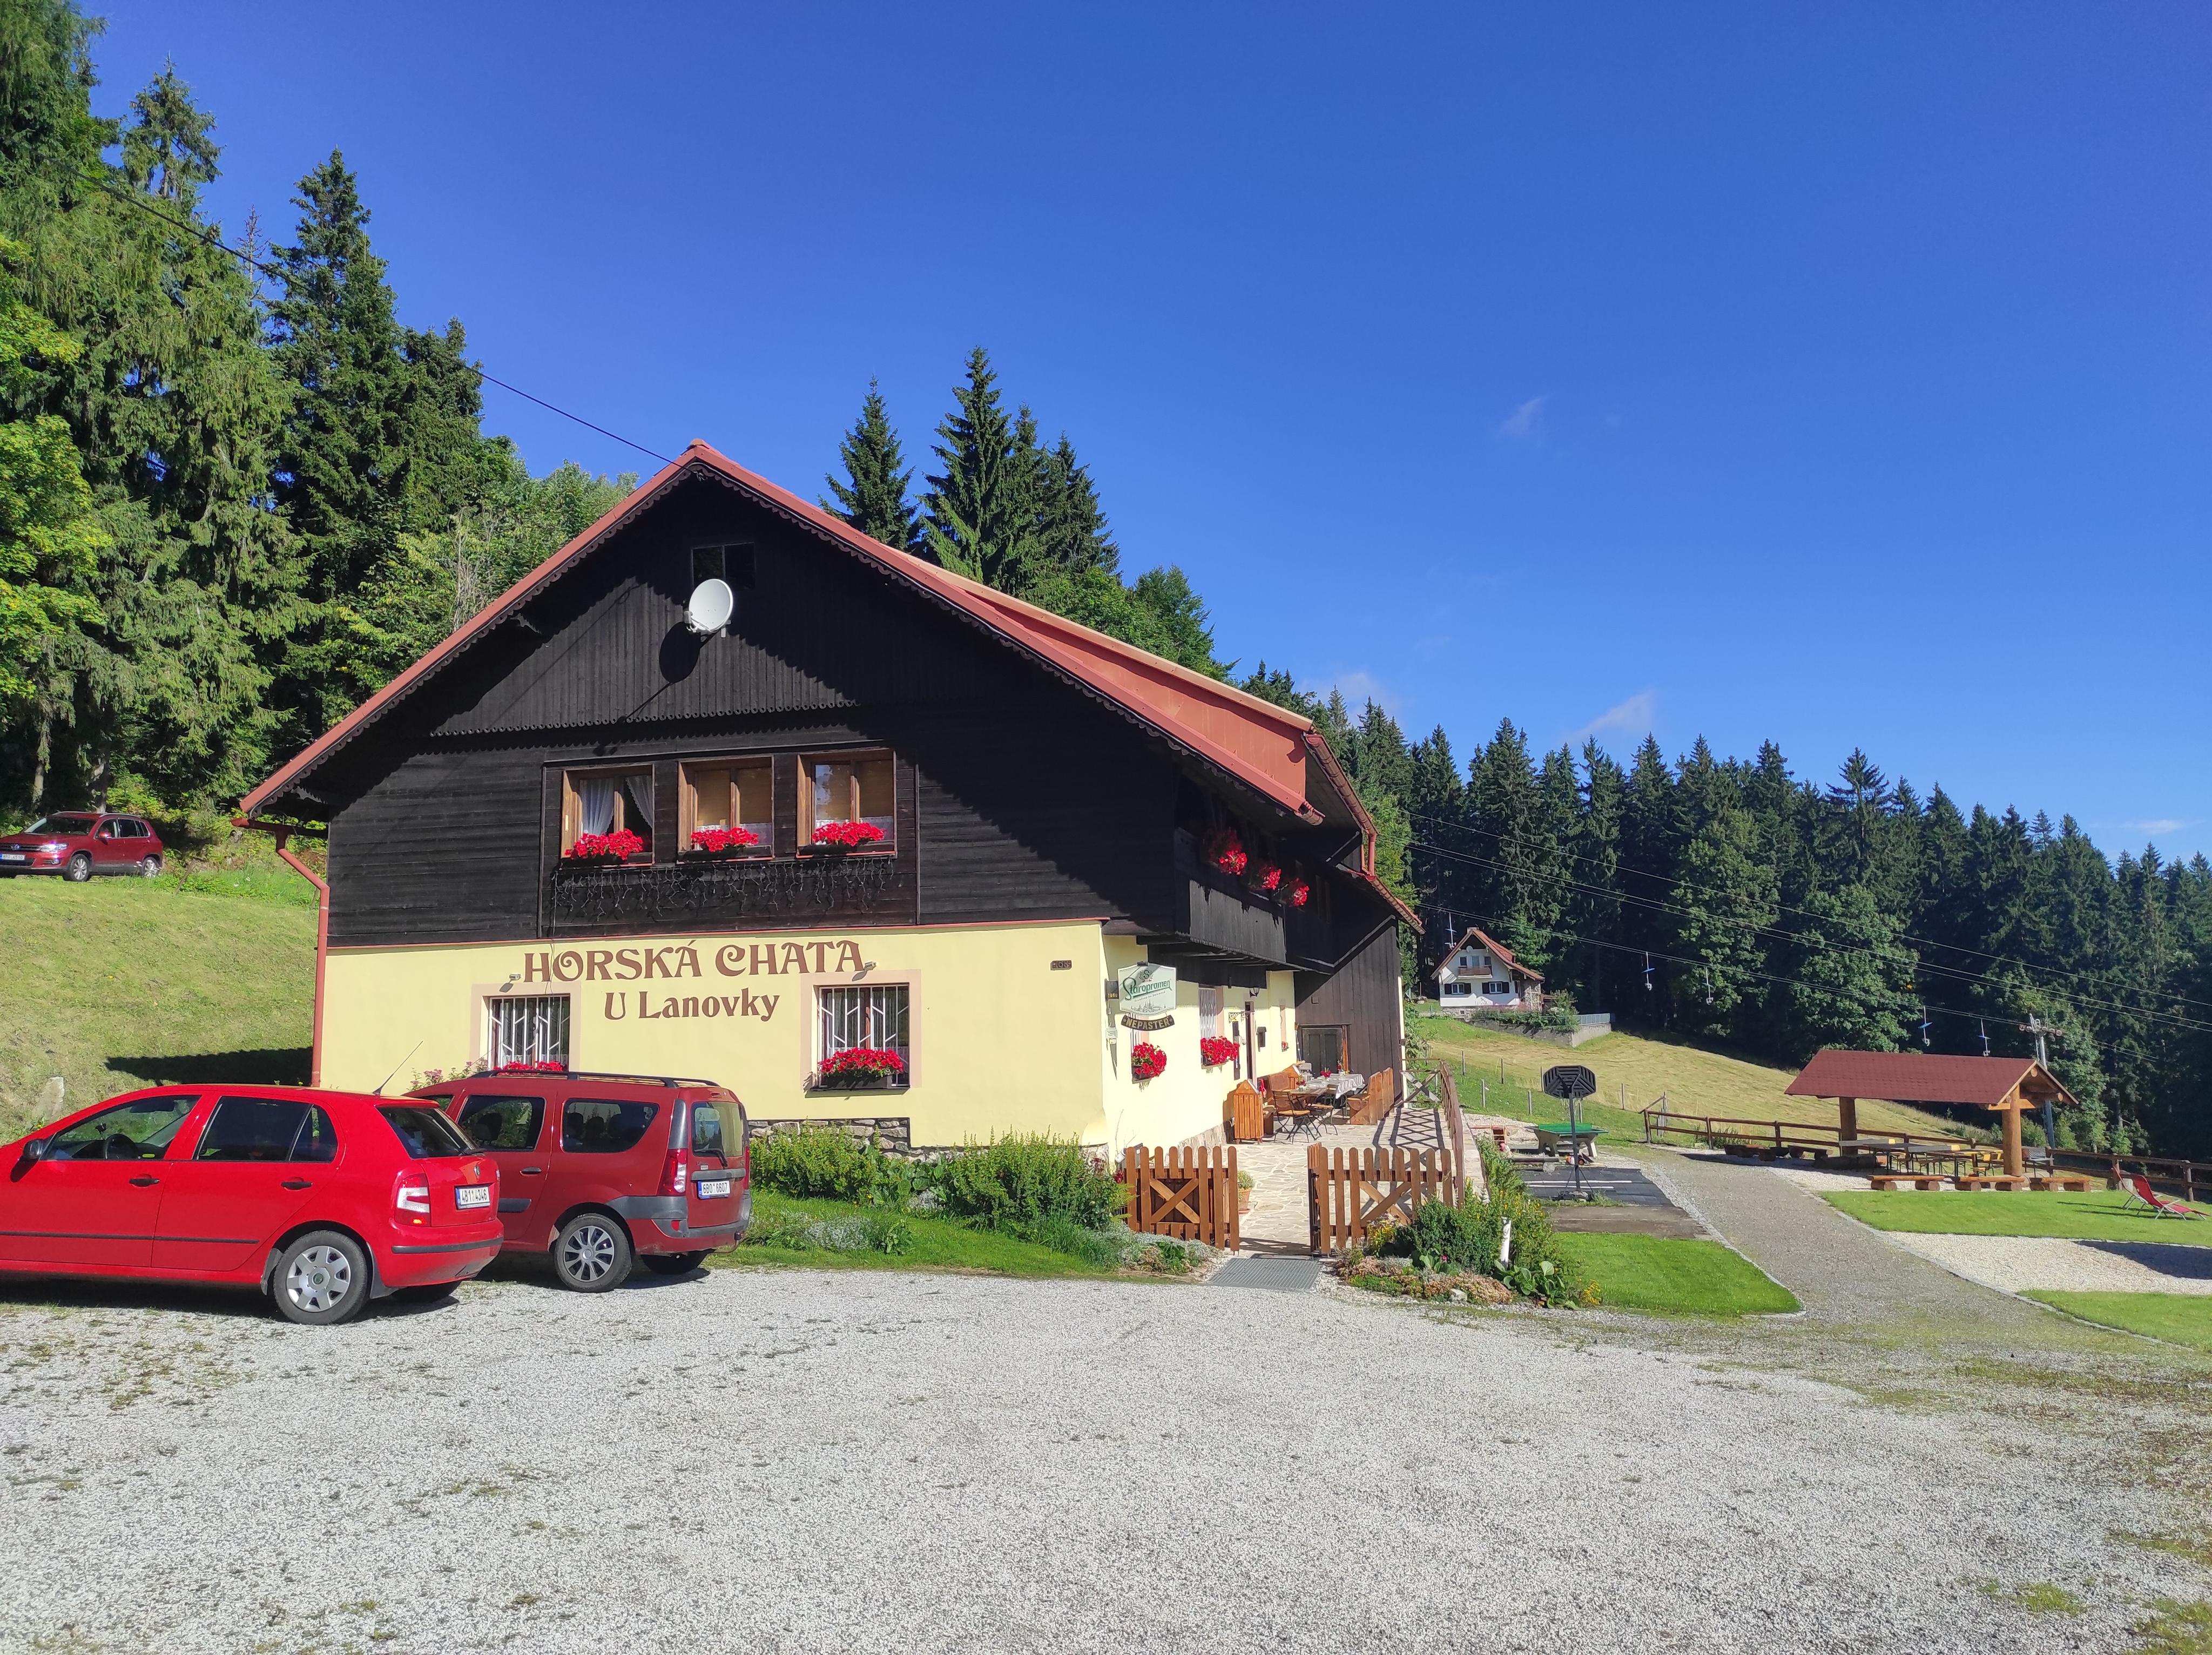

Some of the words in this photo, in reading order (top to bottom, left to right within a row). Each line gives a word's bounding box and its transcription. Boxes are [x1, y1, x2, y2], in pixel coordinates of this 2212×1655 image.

[524, 940, 702, 983] HORSKÁ
[716, 940, 867, 977] CHATA
[1123, 977, 1172, 1001] Staropramen
[604, 992, 626, 1020] U
[638, 987, 780, 1022] Lanovky
[1125, 1017, 1170, 1030] NEPASTER
[475, 1188, 487, 1201] 4346
